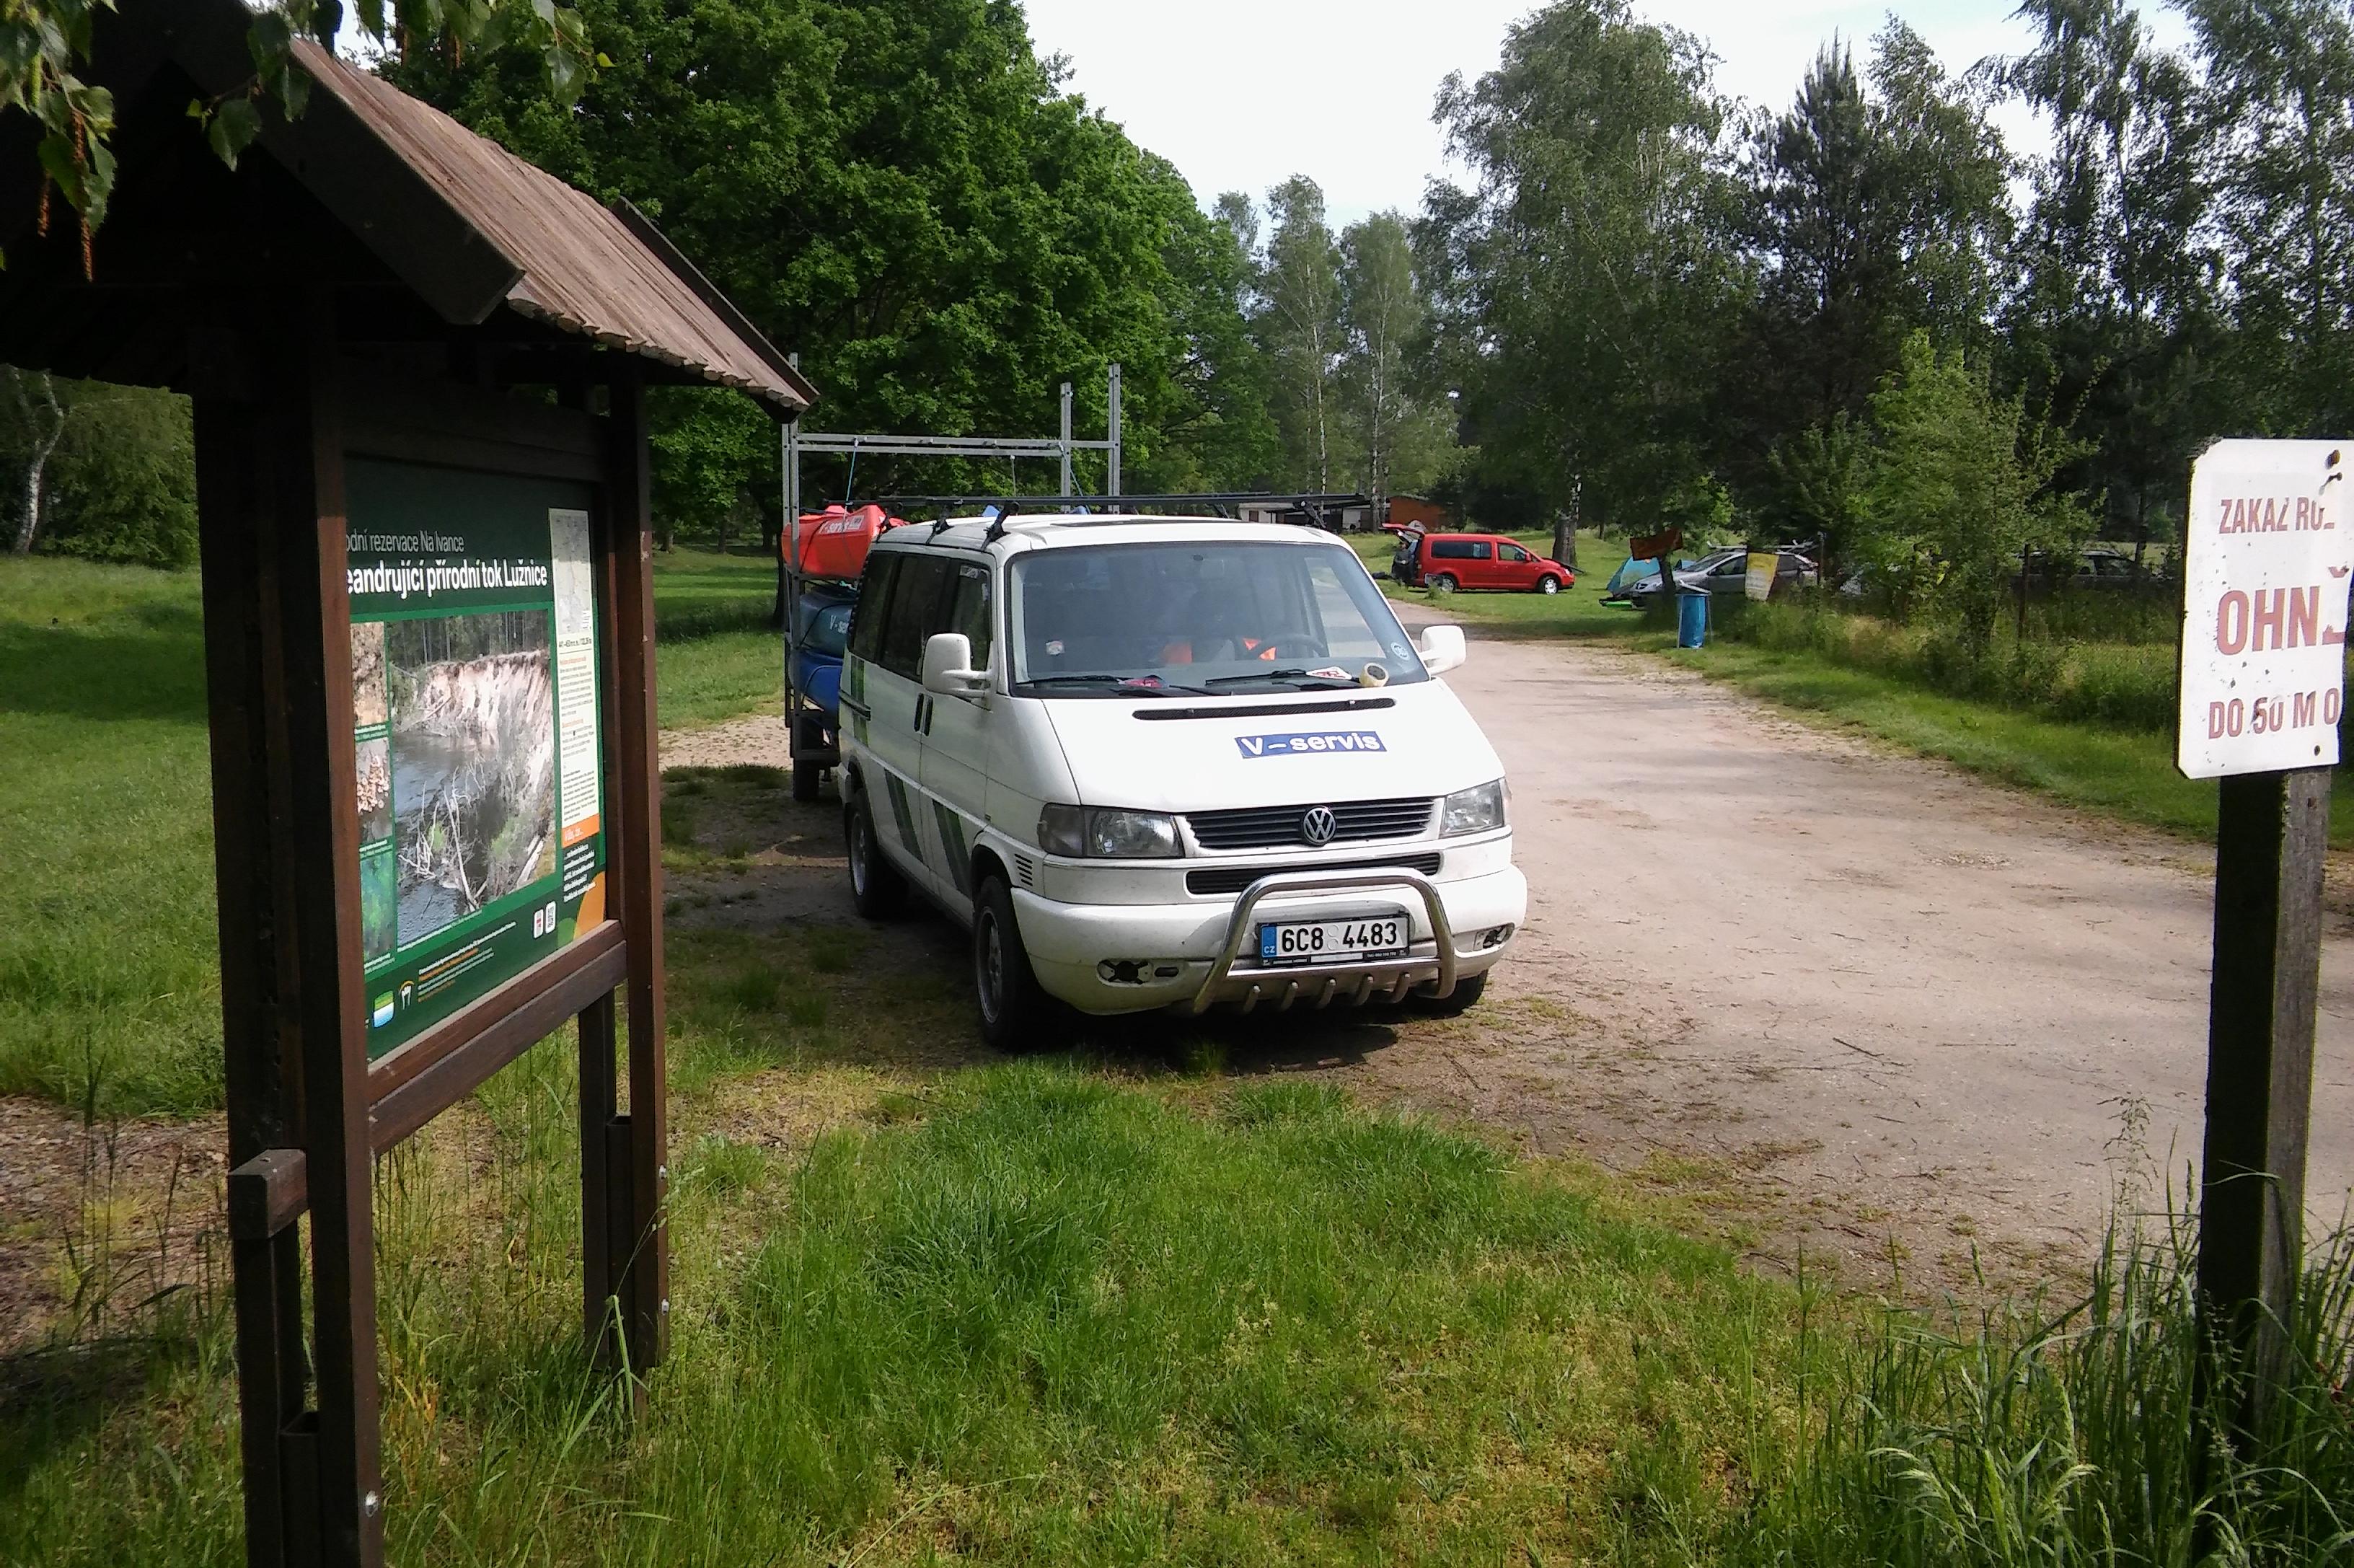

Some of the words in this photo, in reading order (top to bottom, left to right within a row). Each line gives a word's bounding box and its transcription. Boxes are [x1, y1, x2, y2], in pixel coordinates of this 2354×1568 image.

[370, 534, 419, 552] rezervace
[419, 529, 434, 552] Na
[435, 530, 465, 552] Ivance
[426, 558, 480, 598] přírodní
[481, 558, 503, 588] tok
[503, 558, 547, 587] Lužnice
[2208, 697, 2244, 739] DO
[2292, 690, 2316, 728] M
[1264, 946, 1276, 954] CZ
[1282, 927, 1323, 953] 6C8
[1342, 922, 1397, 948] 4483
